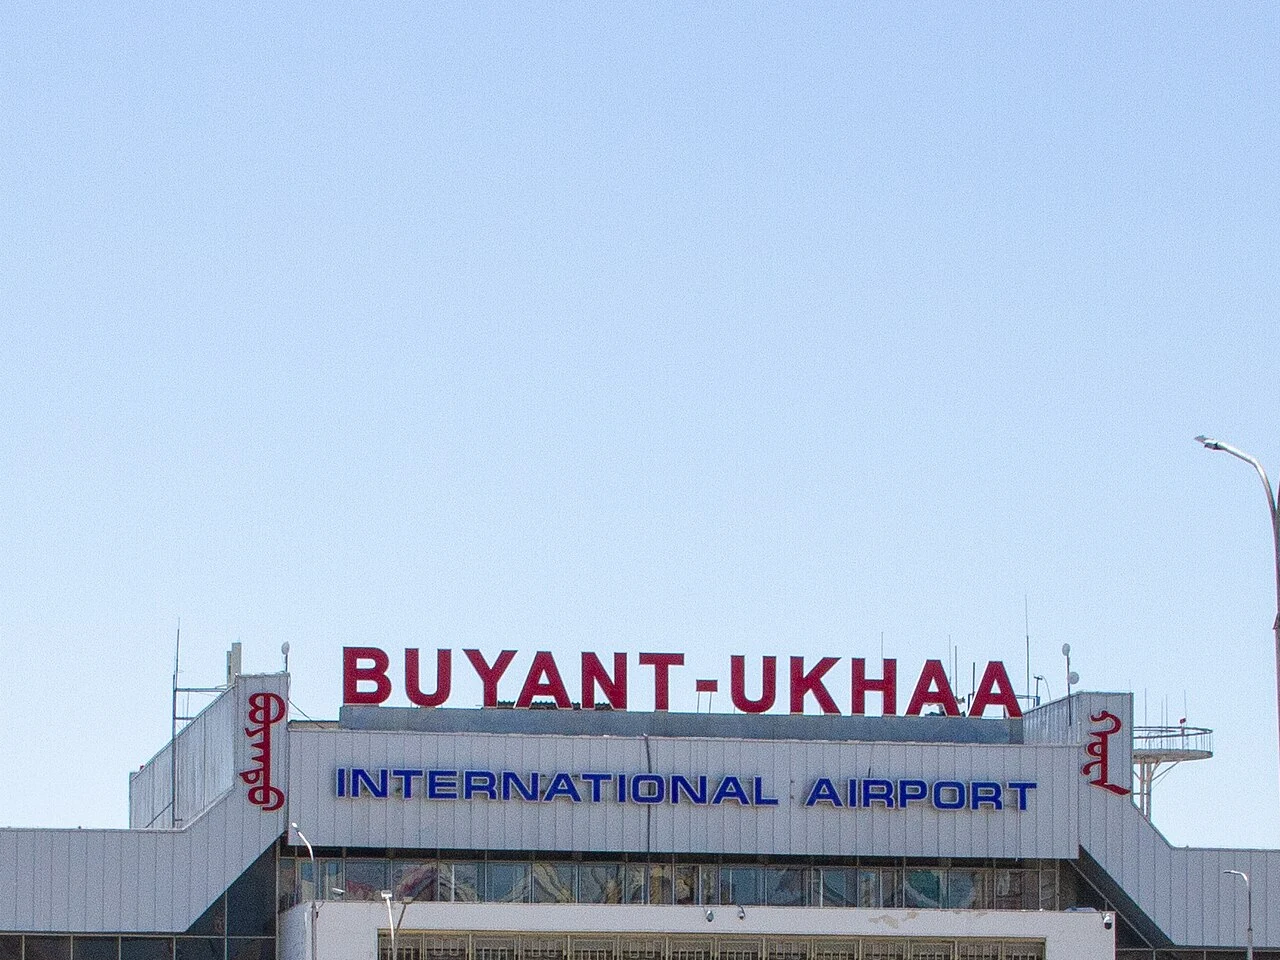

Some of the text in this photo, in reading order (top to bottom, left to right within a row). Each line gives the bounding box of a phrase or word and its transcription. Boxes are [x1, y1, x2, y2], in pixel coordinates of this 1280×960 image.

[341, 645, 1022, 718] BUYANT-UKHAA
[335, 767, 1037, 812] INTERNATIONAL AIRPORT
